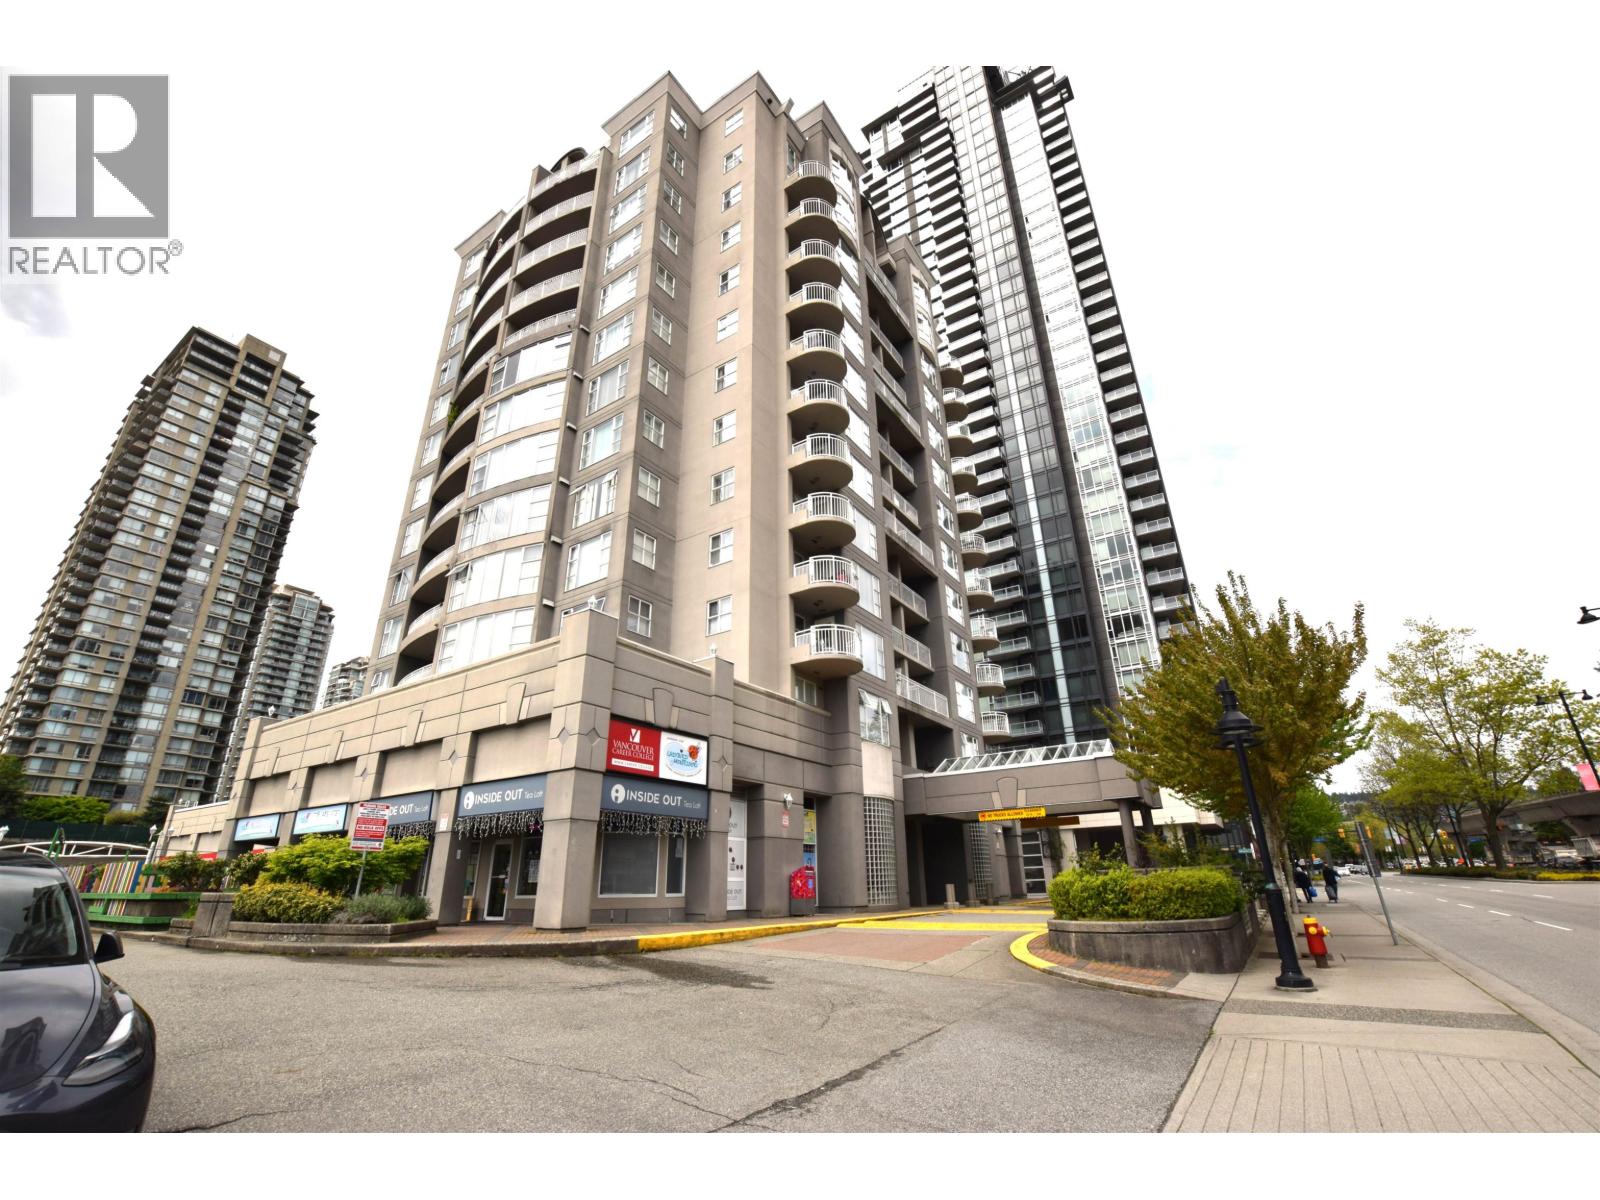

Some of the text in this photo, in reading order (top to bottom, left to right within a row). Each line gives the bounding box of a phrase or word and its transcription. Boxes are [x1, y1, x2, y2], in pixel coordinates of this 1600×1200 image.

[613, 739, 654, 755] VANCOUVER
[474, 791, 502, 805] INSIDE
[504, 789, 524, 801] OUT
[626, 789, 660, 804] INSIDE
[662, 794, 682, 807] OUT
[399, 803, 414, 815] OUT
